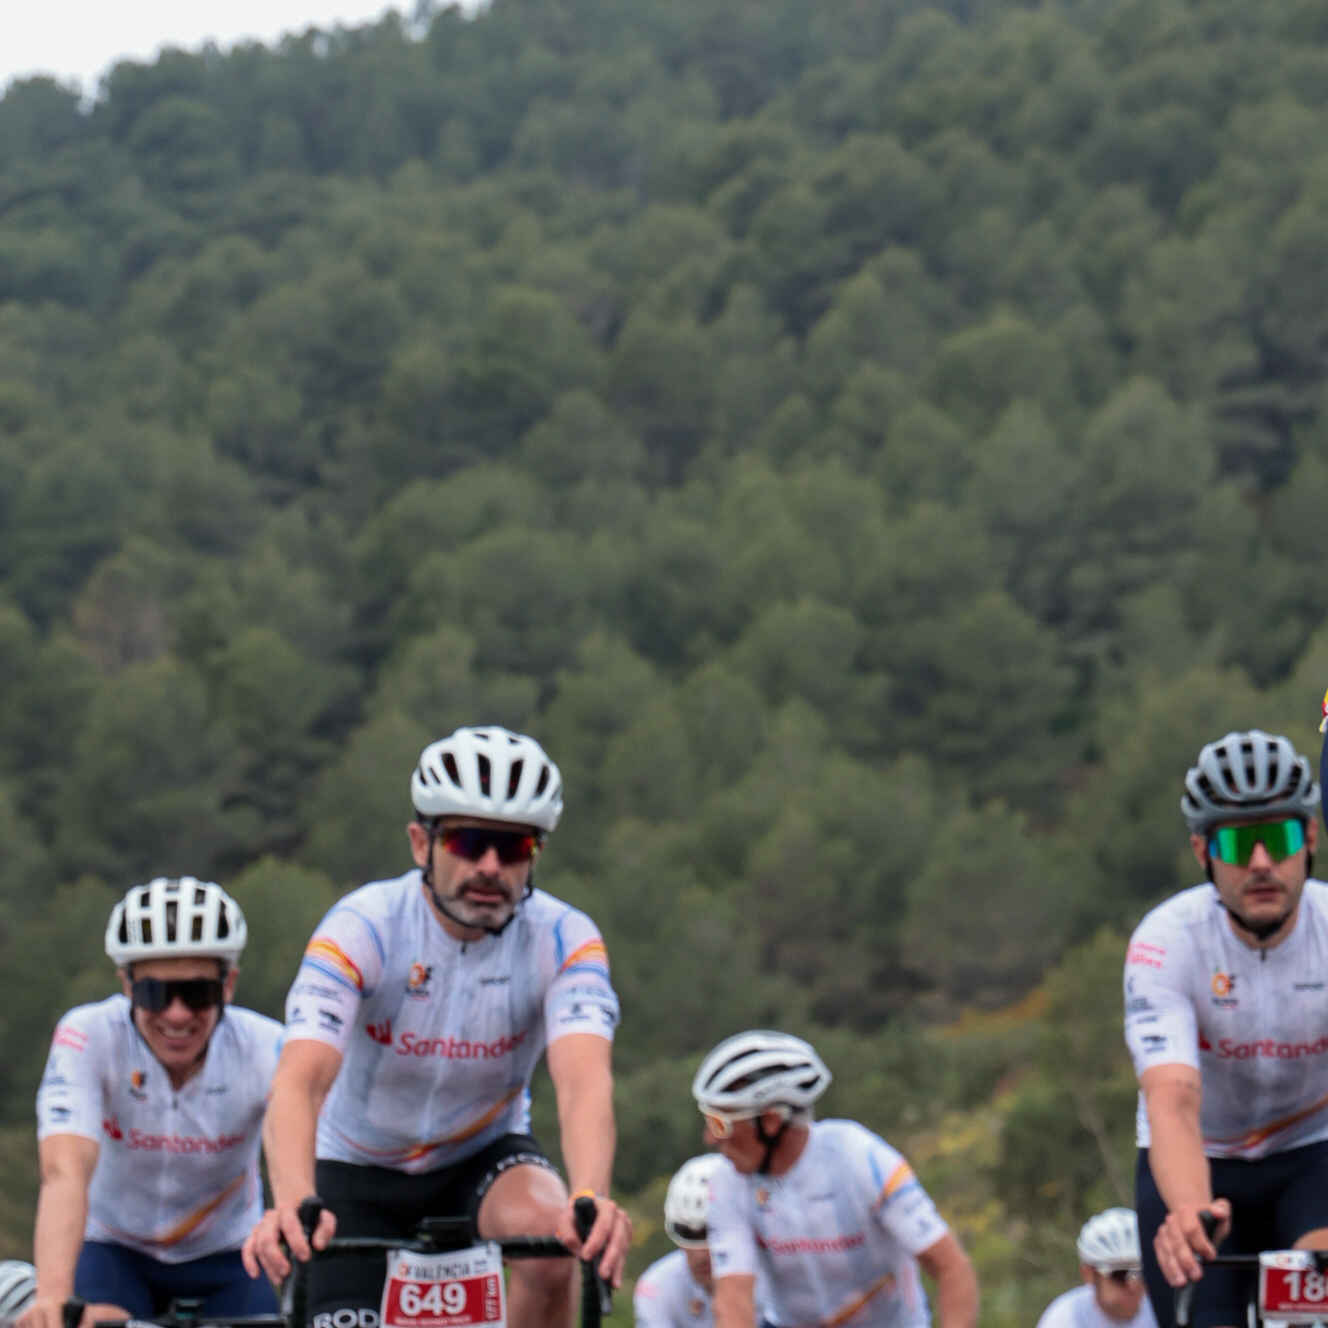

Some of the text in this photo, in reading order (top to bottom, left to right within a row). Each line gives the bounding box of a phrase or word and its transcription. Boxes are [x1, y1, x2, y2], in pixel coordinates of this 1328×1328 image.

[395, 1029, 527, 1060] Santander
[127, 1128, 246, 1154] Santander
[398, 1282, 468, 1317] 649
